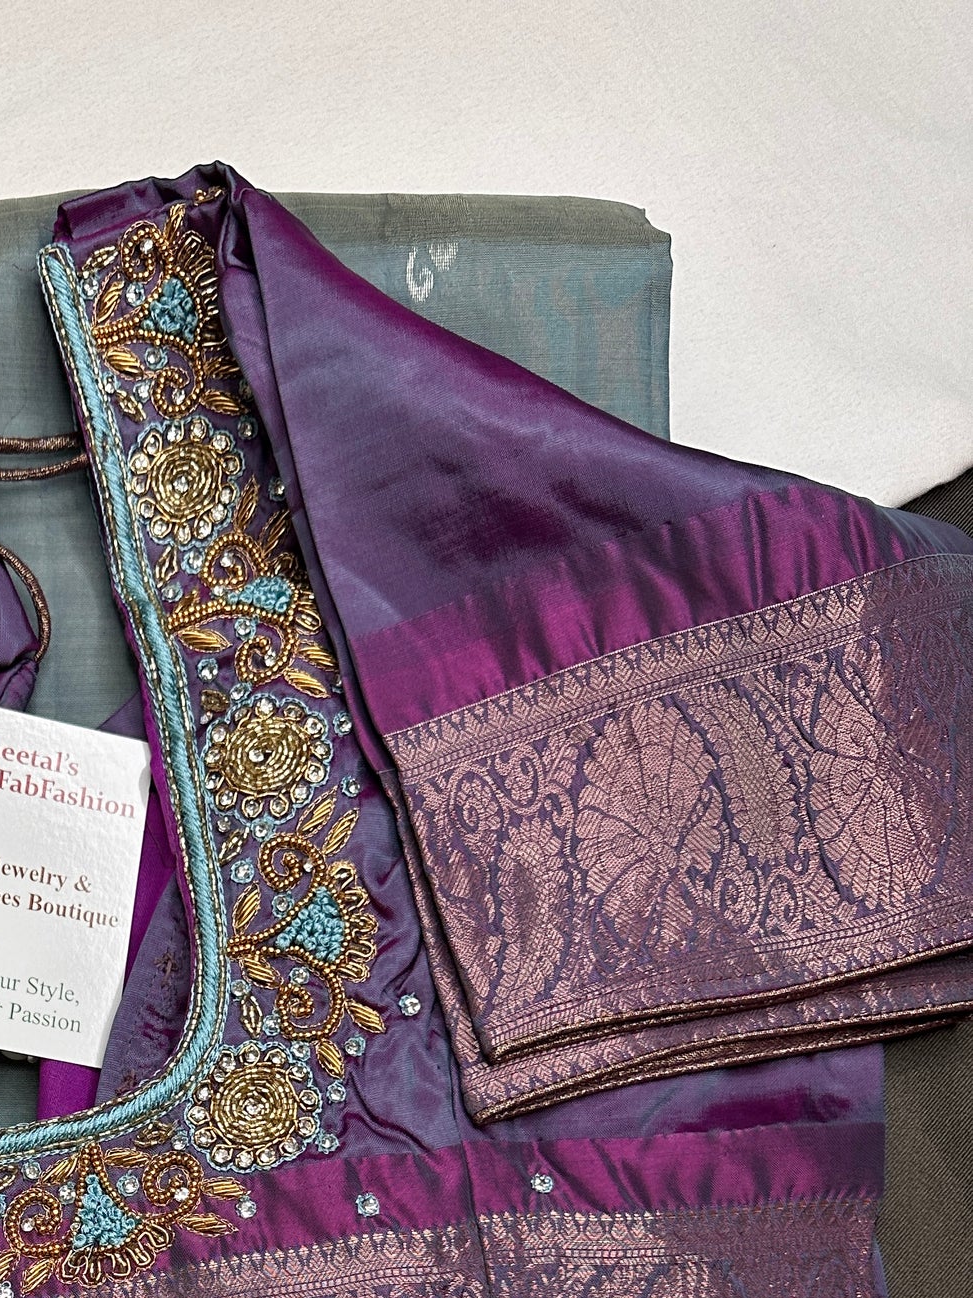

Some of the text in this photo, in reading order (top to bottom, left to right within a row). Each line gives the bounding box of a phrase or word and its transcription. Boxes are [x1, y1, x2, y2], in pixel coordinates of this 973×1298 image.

[74, 875, 92, 893] &
[28, 894, 119, 928] Boutique
[26, 978, 79, 1006] Style,
[8, 1003, 81, 1033] Passion
